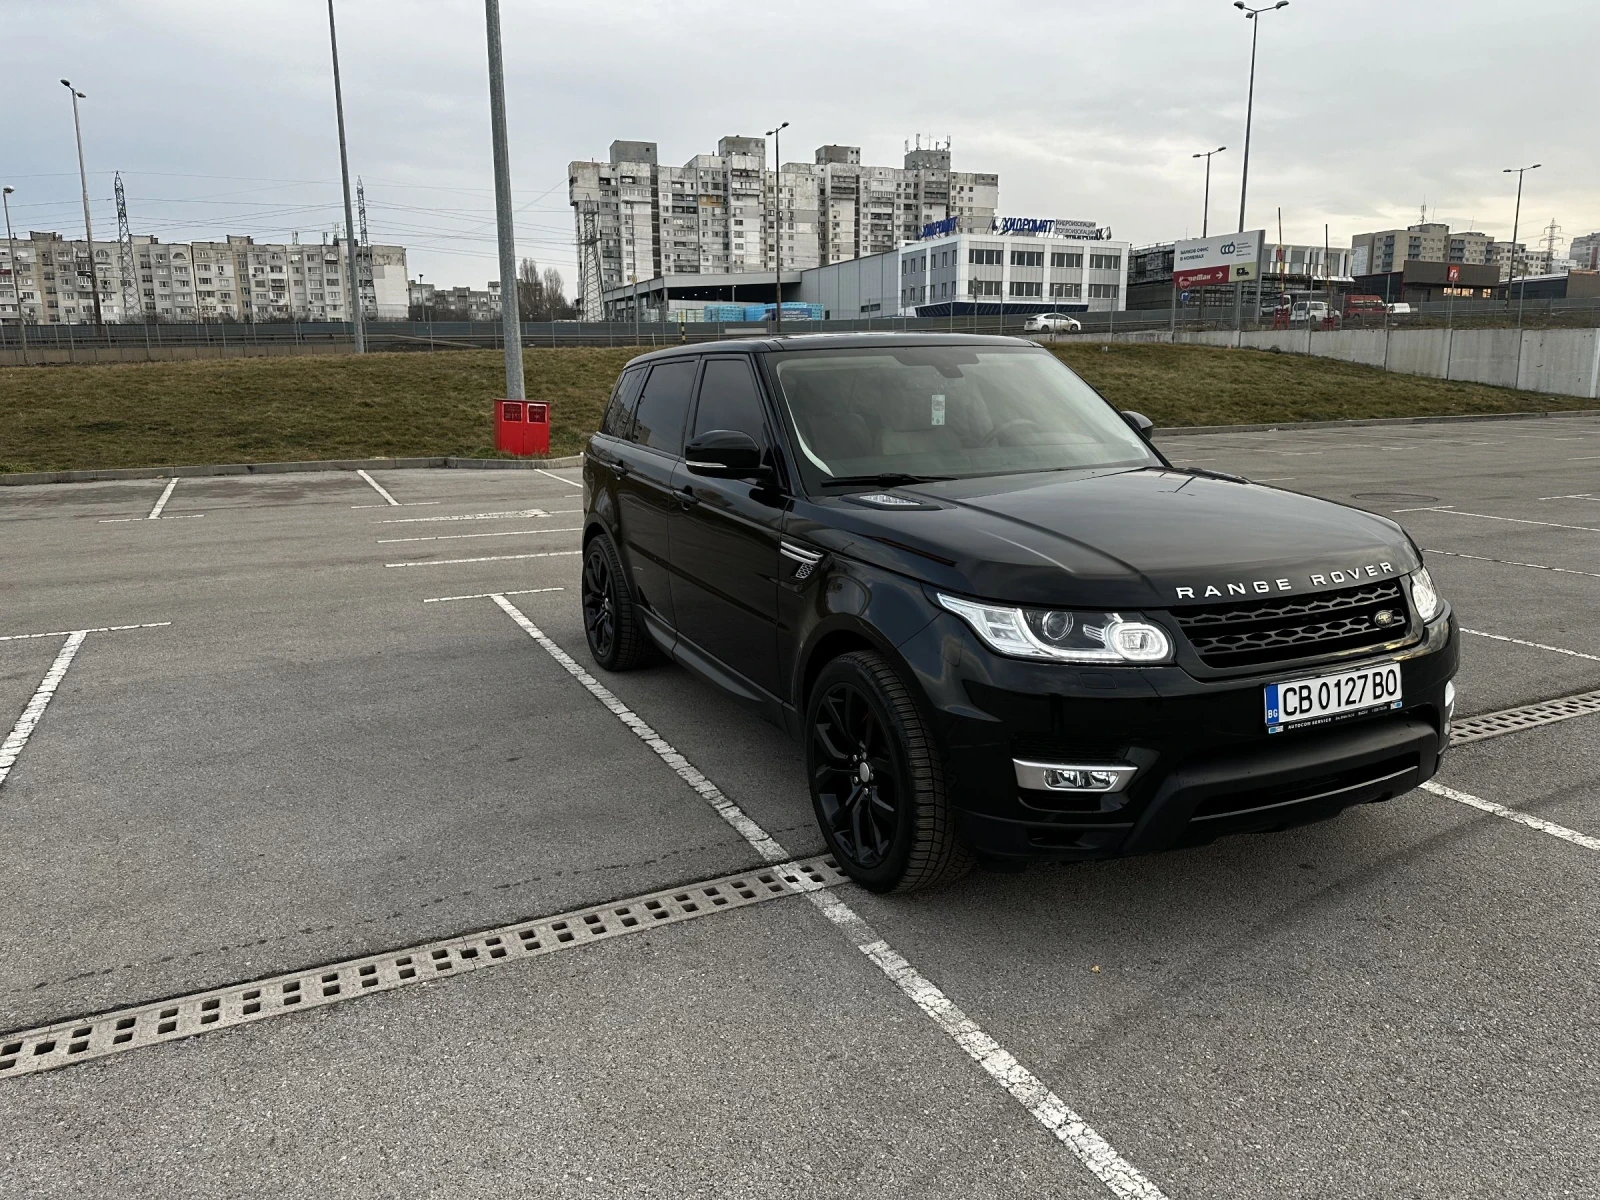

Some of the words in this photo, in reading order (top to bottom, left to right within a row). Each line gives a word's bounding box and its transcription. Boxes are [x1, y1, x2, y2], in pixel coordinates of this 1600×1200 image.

[1002, 217, 1055, 232] ХИДРОМАТ
[1176, 578, 1292, 599] RANGE
[1309, 561, 1394, 586] ROVER
[1282, 683, 1313, 716] CB
[1318, 674, 1368, 709] 0127
[1372, 669, 1398, 700] BO
[1267, 709, 1278, 719] BG
[1287, 721, 1311, 730] AUTOCOM
[1312, 717, 1332, 725] SERVICE
